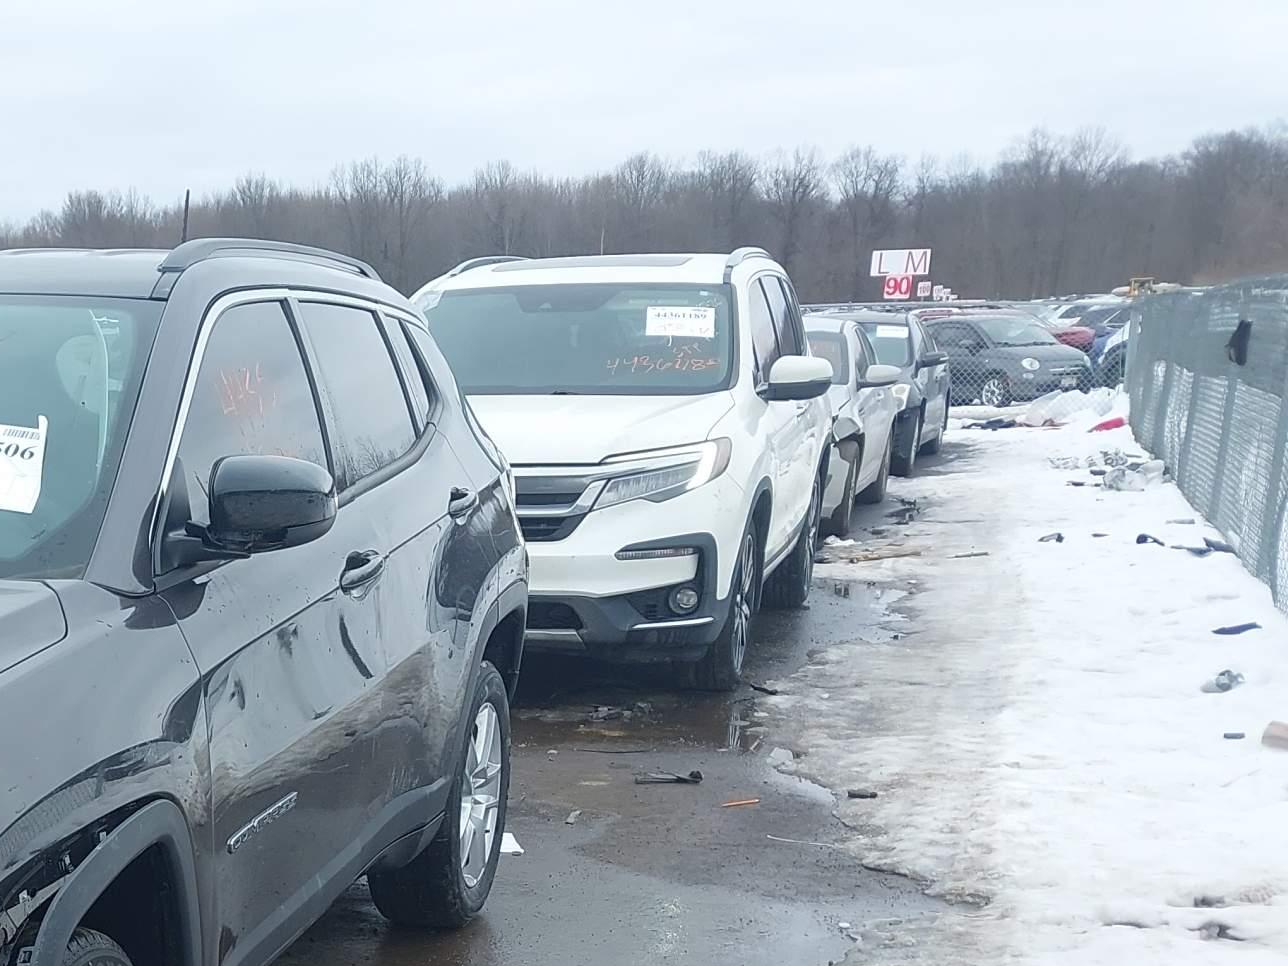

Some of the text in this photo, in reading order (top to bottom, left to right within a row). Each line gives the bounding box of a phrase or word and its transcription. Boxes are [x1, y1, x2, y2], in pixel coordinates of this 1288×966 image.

[878, 250, 928, 275] L M
[885, 276, 911, 296] 90
